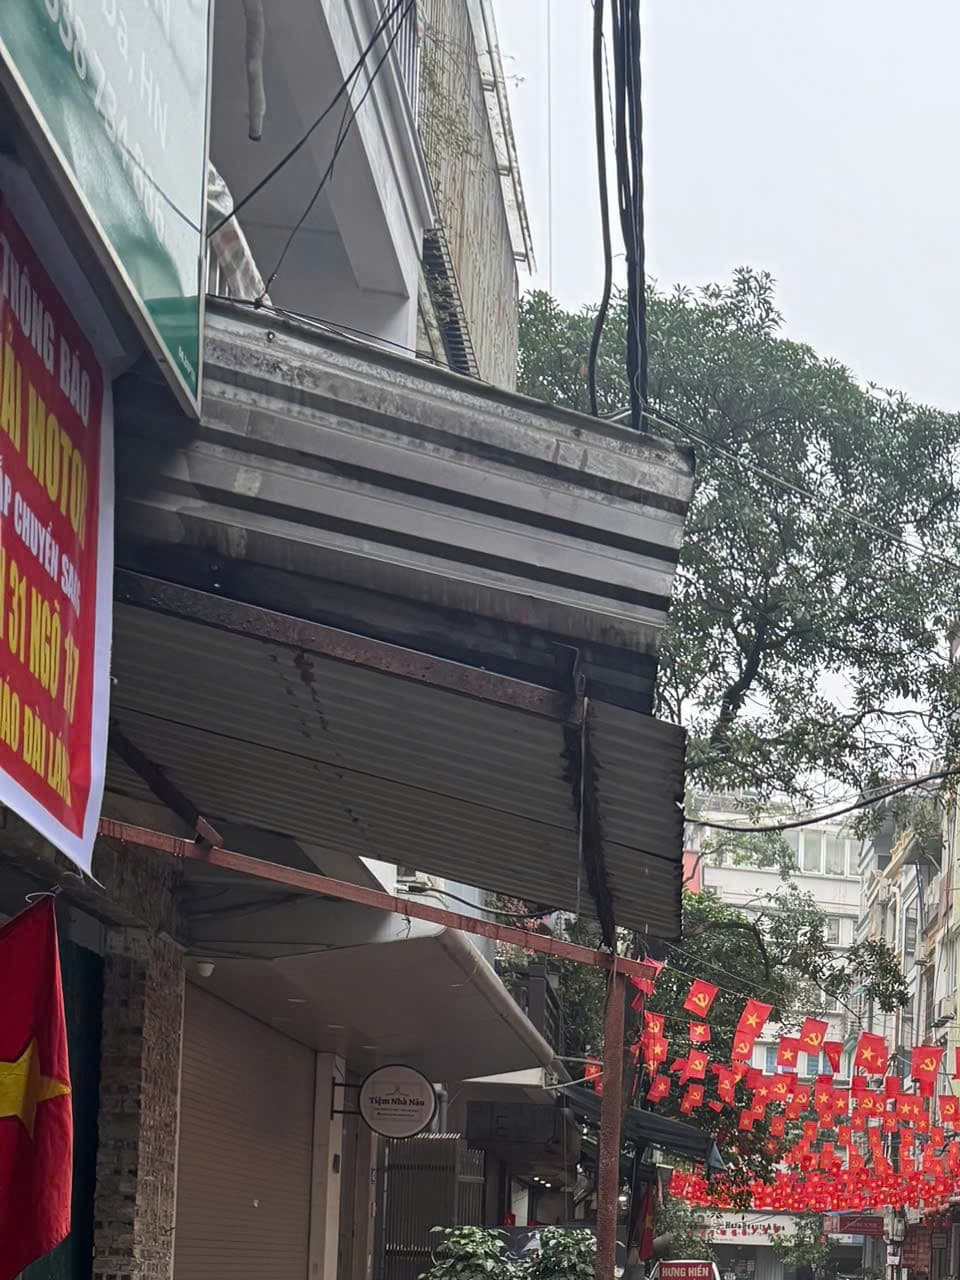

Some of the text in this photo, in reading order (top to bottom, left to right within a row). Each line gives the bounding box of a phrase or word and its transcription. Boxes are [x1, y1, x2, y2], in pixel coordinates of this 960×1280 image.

[59, 335, 91, 428] BÁO
[9, 558, 27, 665] 31
[0, 674, 20, 753] ÁO
[23, 704, 46, 779] ĐÀI
